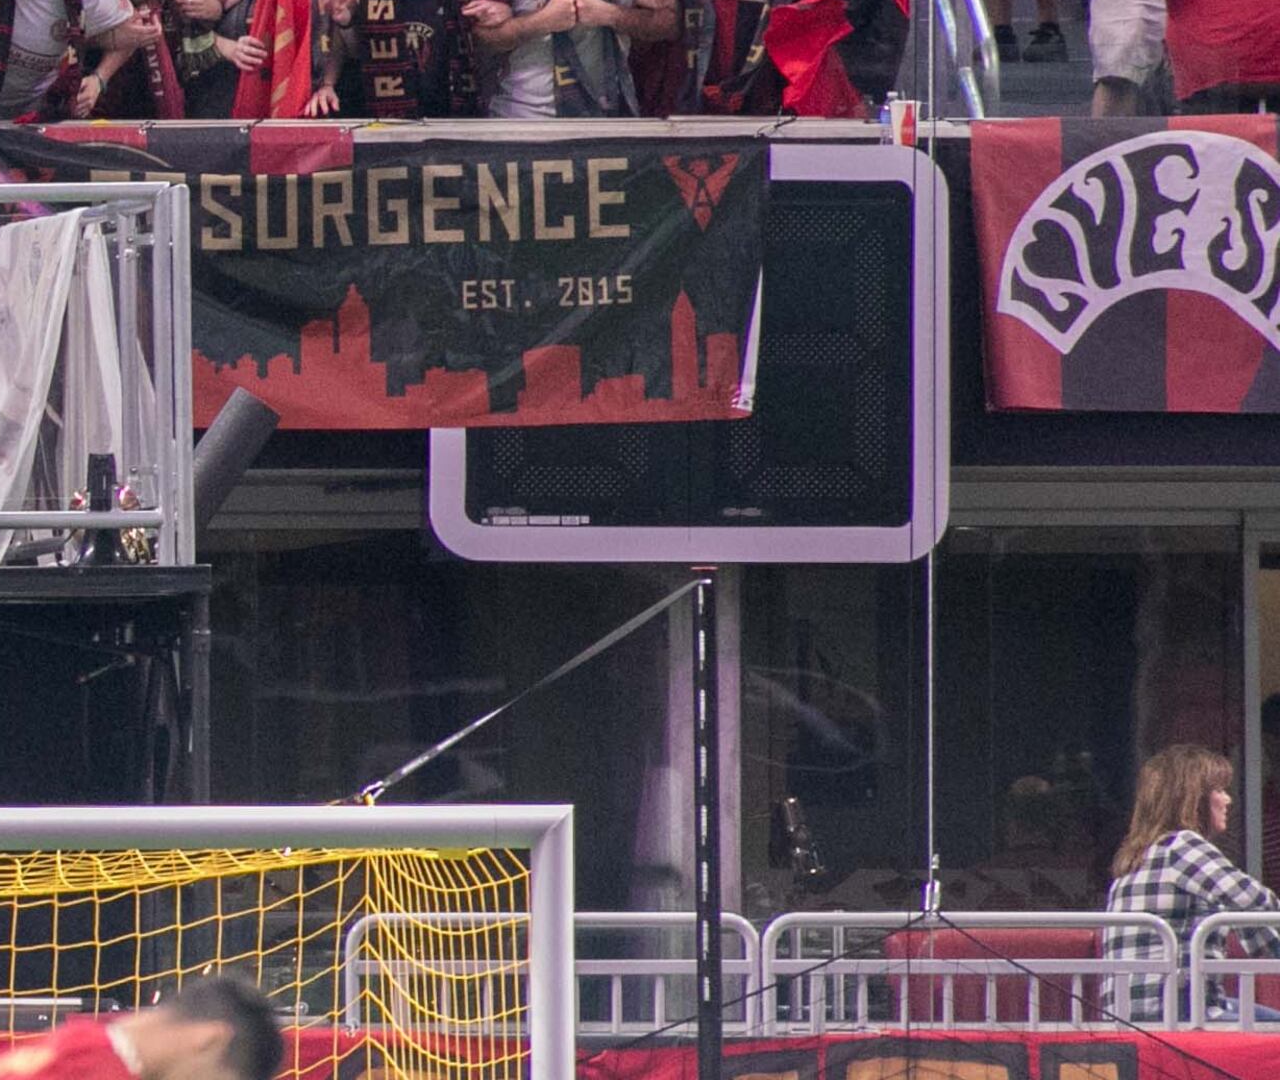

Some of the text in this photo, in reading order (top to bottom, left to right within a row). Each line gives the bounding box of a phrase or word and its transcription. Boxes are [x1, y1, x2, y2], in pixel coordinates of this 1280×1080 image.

[134, 157, 631, 251] SURGENCE
[462, 274, 634, 309] EST. 2015
